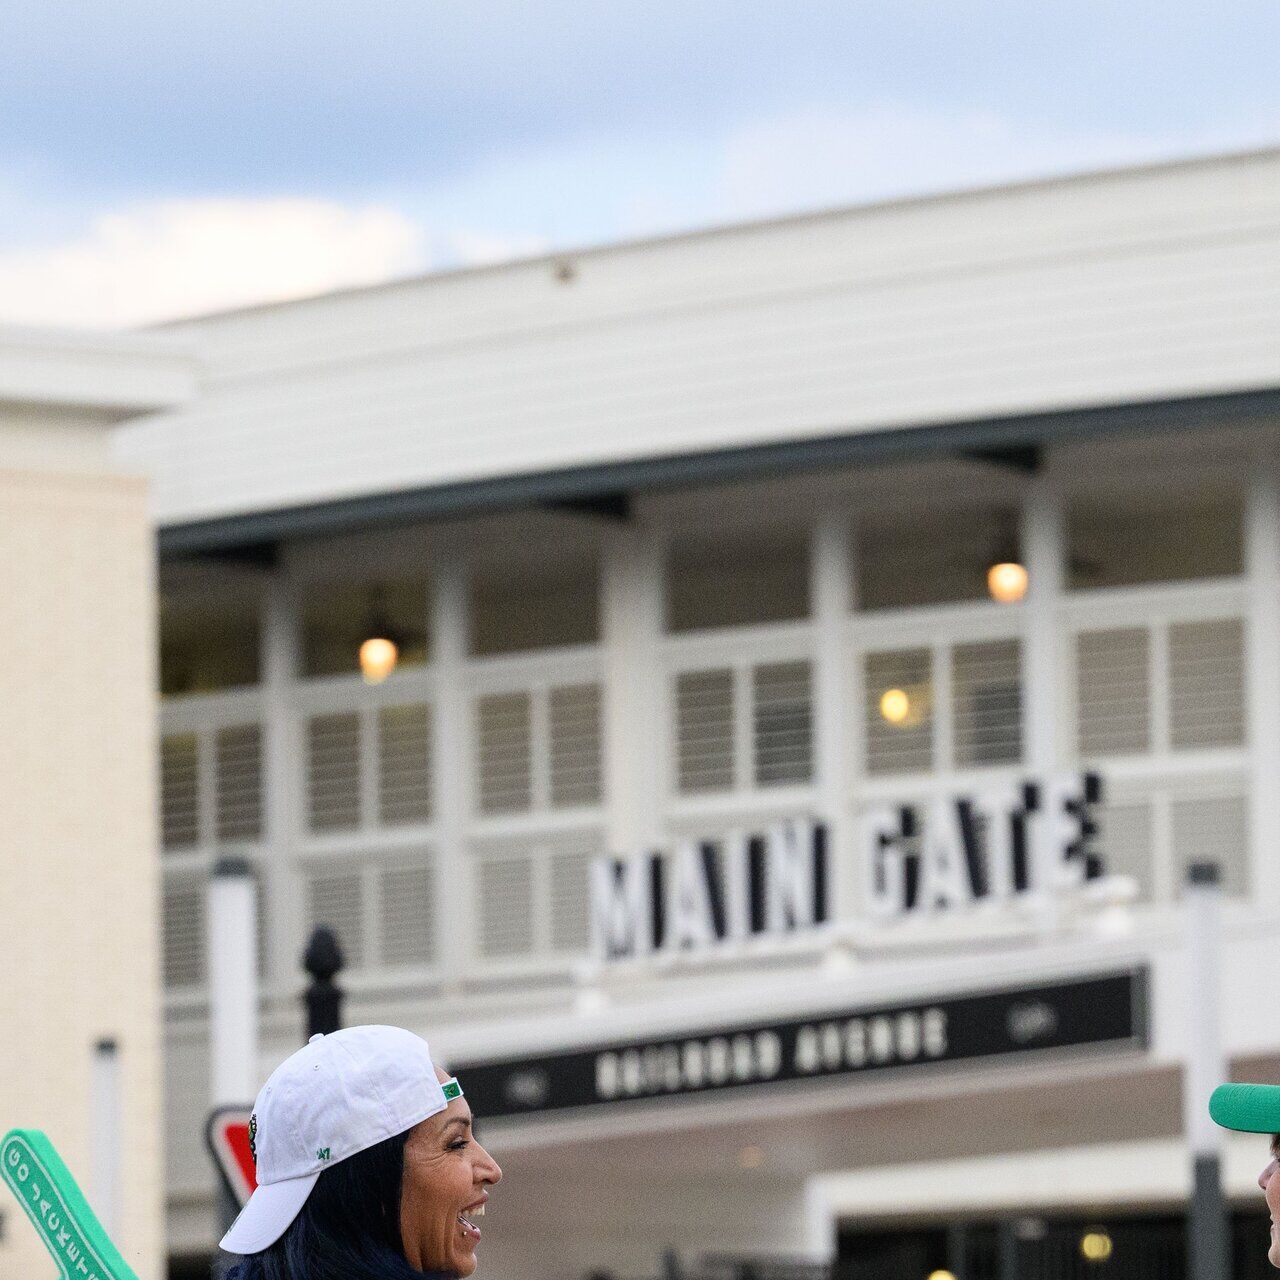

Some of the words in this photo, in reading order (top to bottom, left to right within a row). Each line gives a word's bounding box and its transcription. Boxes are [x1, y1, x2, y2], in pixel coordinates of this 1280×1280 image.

[591, 822, 827, 960] MAIN
[866, 774, 1102, 916] GATE
[795, 1007, 948, 1070] AVENUE
[8, 1148, 30, 1182] GO
